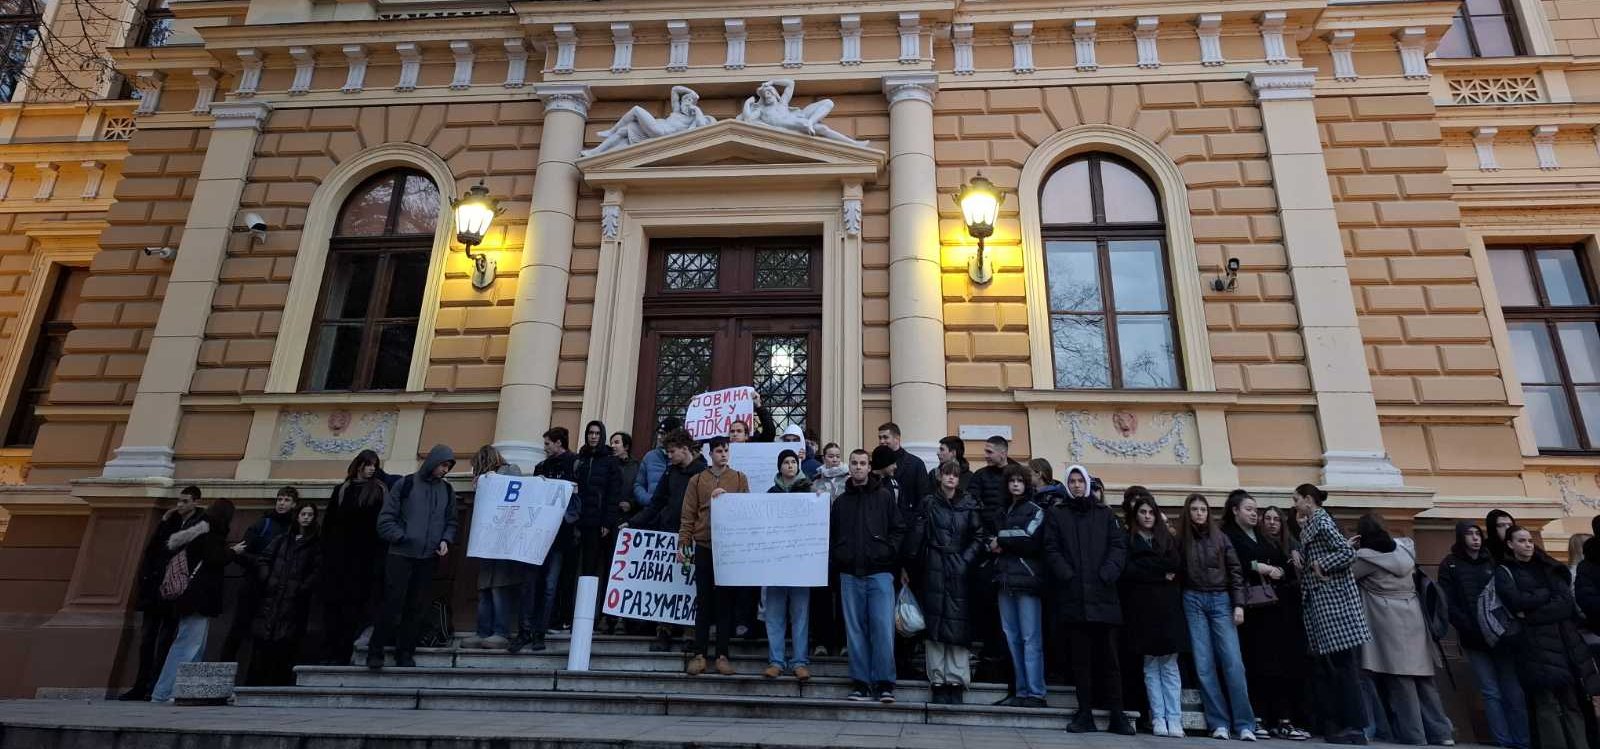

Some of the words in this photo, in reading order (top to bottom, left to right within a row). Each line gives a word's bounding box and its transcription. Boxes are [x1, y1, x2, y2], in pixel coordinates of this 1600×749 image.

[693, 389, 749, 408] ЈОВИНА
[703, 407, 722, 420] ЈЕ
[728, 403, 737, 415] У
[685, 413, 753, 440] БЛОКАИ
[633, 531, 680, 551] ОТКА
[611, 560, 627, 581] 2
[628, 560, 673, 583] ЈАВНА
